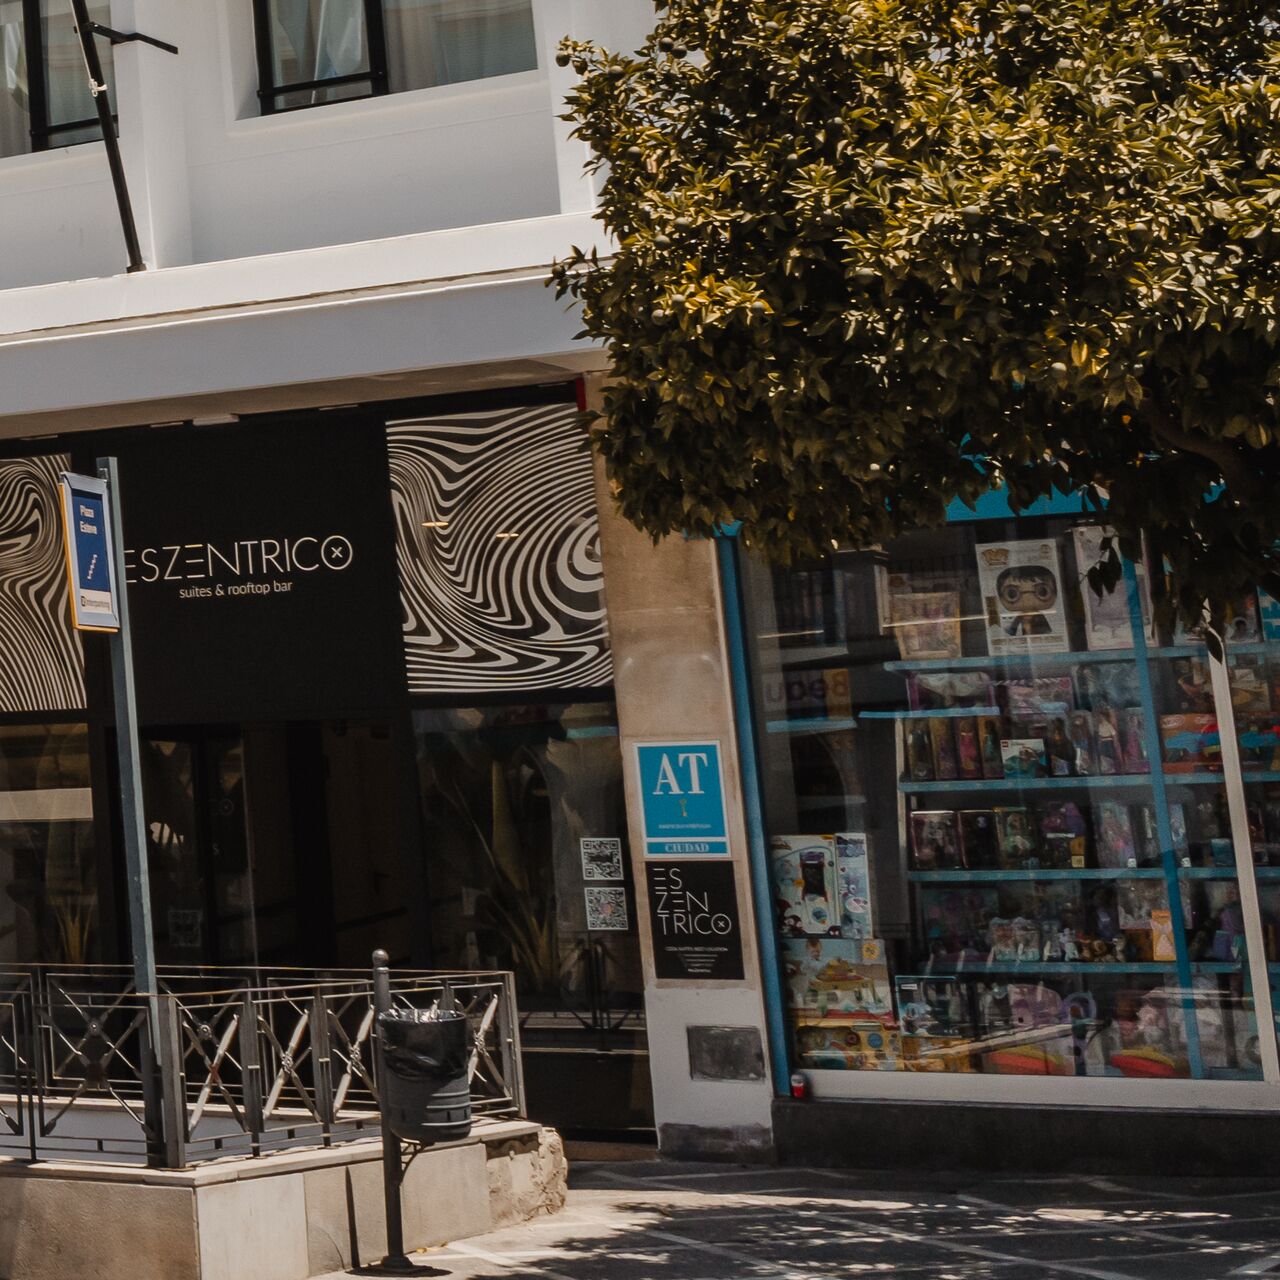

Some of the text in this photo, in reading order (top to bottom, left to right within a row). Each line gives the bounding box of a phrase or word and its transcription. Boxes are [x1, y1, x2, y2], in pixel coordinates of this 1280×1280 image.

[123, 534, 354, 583] ESZENTRICO
[179, 580, 293, 599] suites & rooftop bar
[652, 752, 709, 795] AT
[664, 843, 710, 853] CIUDAD
[653, 868, 683, 890] ES
[655, 890, 709, 913] ZEN
[657, 913, 732, 936] TRICO
